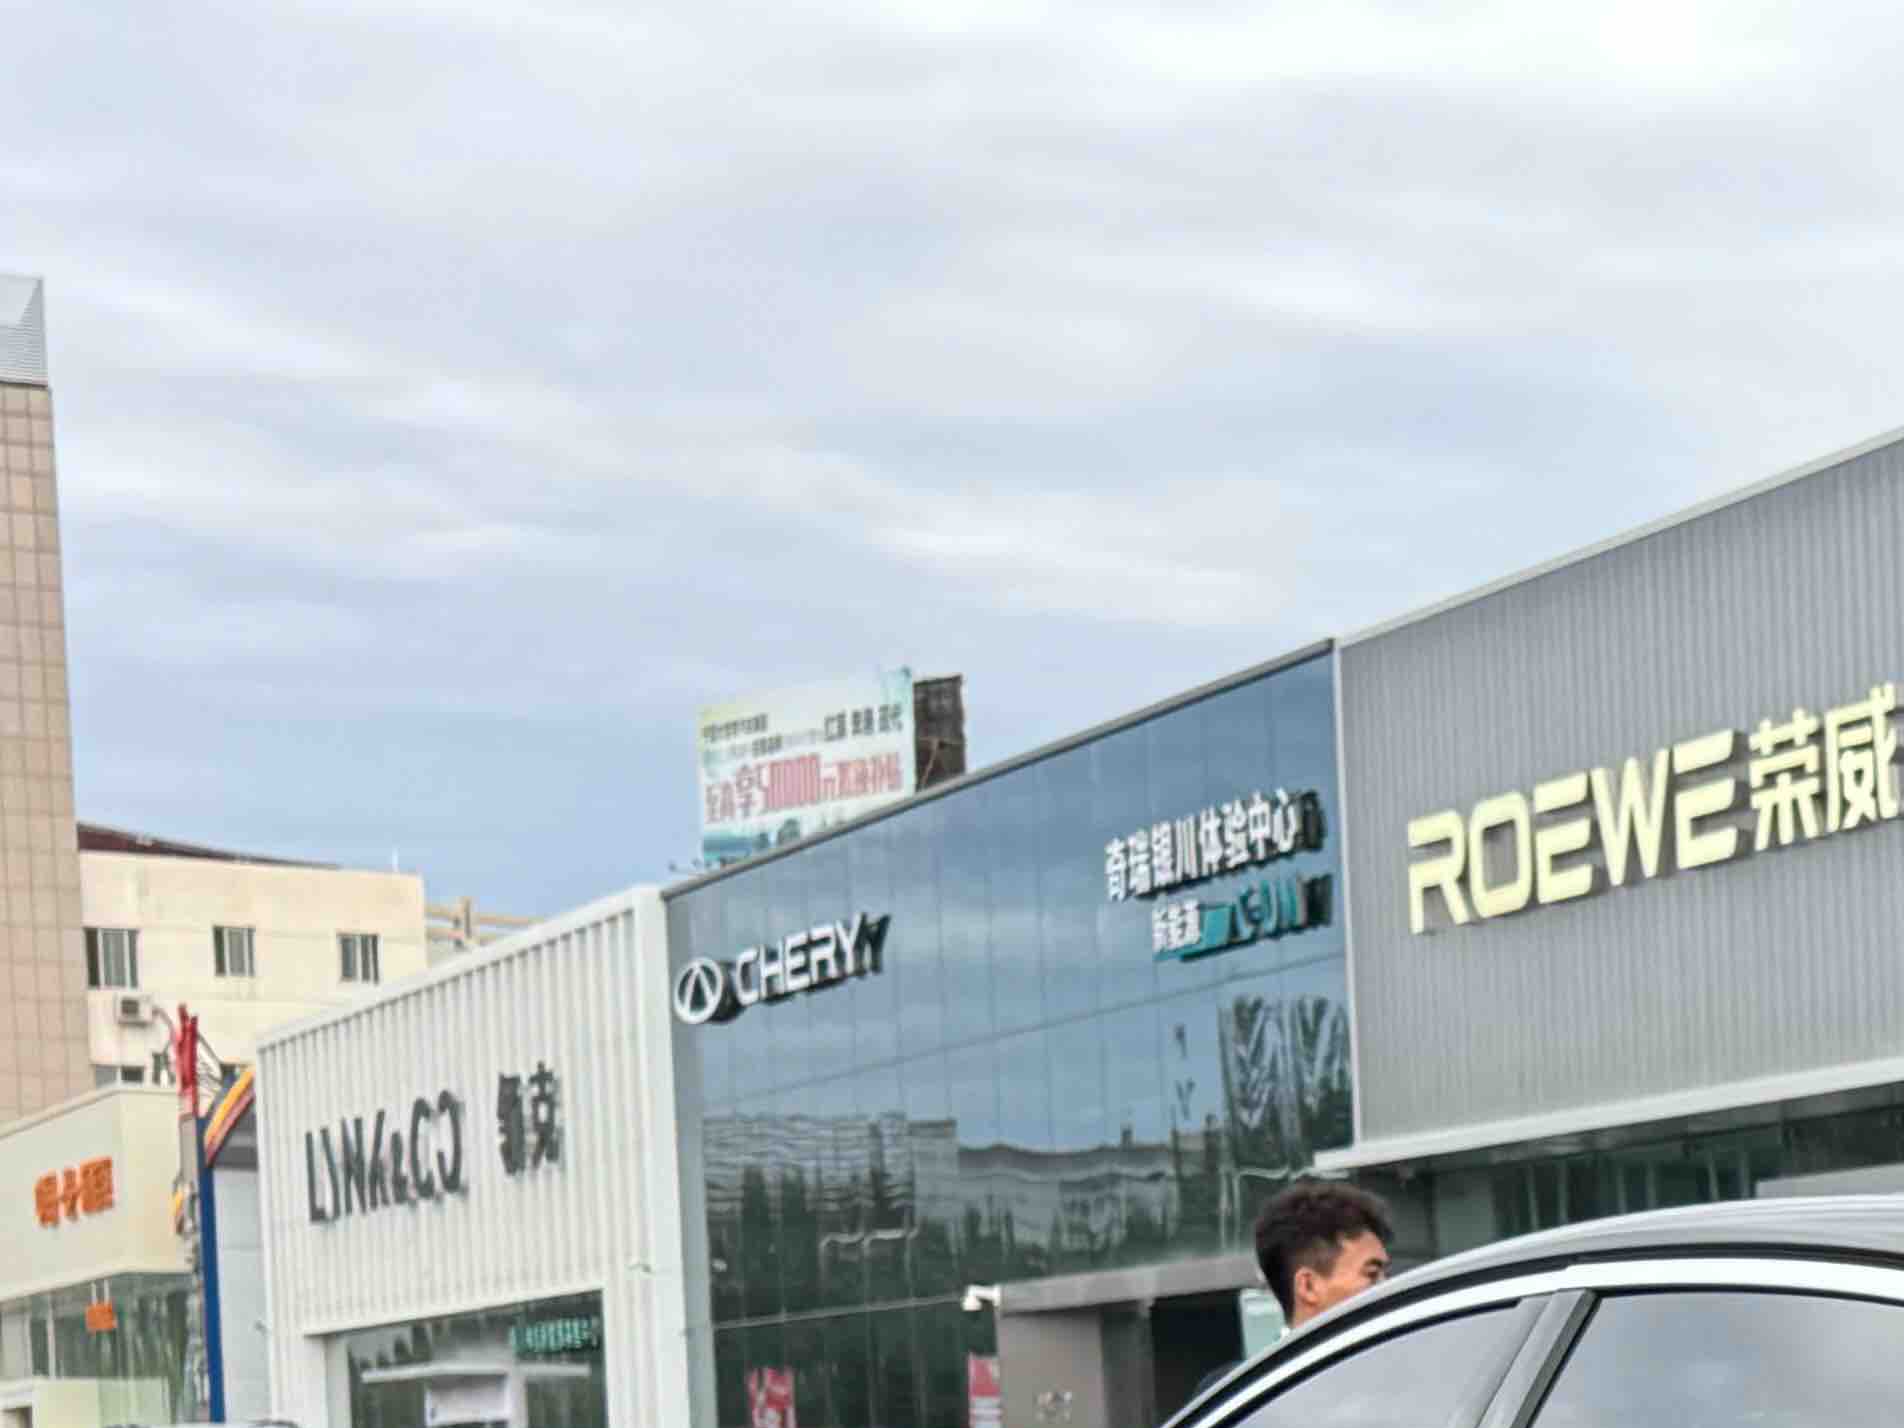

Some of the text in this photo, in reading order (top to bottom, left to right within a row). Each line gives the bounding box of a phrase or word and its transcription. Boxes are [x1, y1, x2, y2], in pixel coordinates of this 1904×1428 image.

[1104, 787, 1300, 902] 奇瑞银川体验中心
[1408, 728, 1738, 934] ROEWE
[1748, 682, 1904, 852] 荣威
[735, 912, 864, 1006] CHERY
